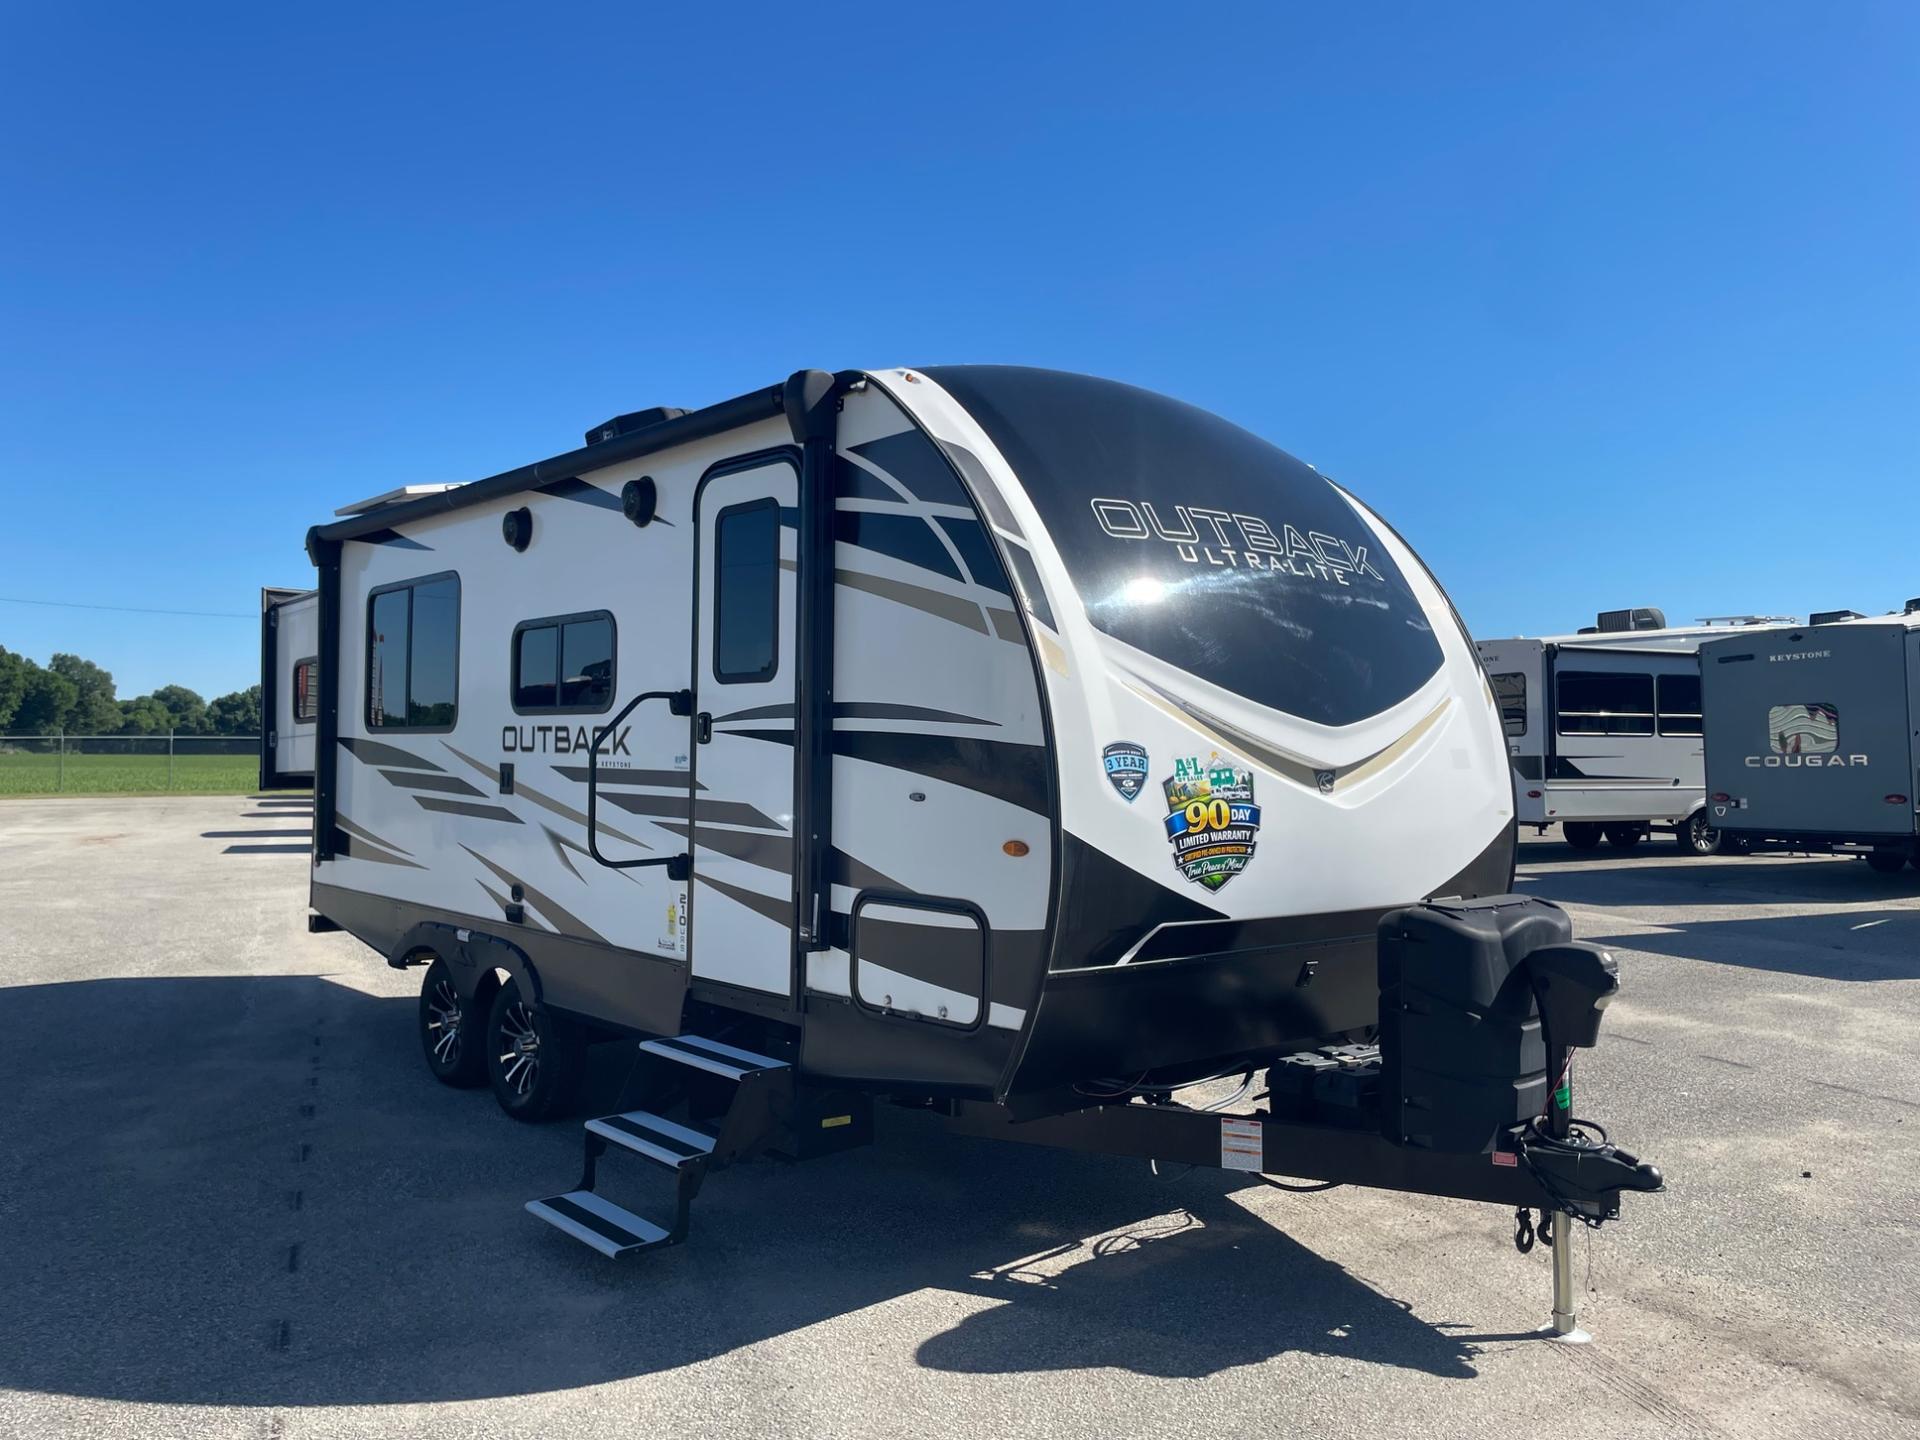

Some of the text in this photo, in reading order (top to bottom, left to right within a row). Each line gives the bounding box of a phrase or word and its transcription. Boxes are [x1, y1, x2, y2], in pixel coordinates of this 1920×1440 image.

[1090, 498, 1384, 582] OUTBACK
[1769, 650, 1831, 662] KEYSTONE
[1106, 756, 1145, 770] 3 YEAR
[1744, 754, 1868, 768] COUGAR
[1185, 799, 1251, 833] 90 DAY
[1179, 830, 1251, 849] LIMITED WARRANTY
[1185, 863, 1202, 878] True
[1202, 861, 1221, 874] Peace
[1226, 858, 1245, 870] Mind
